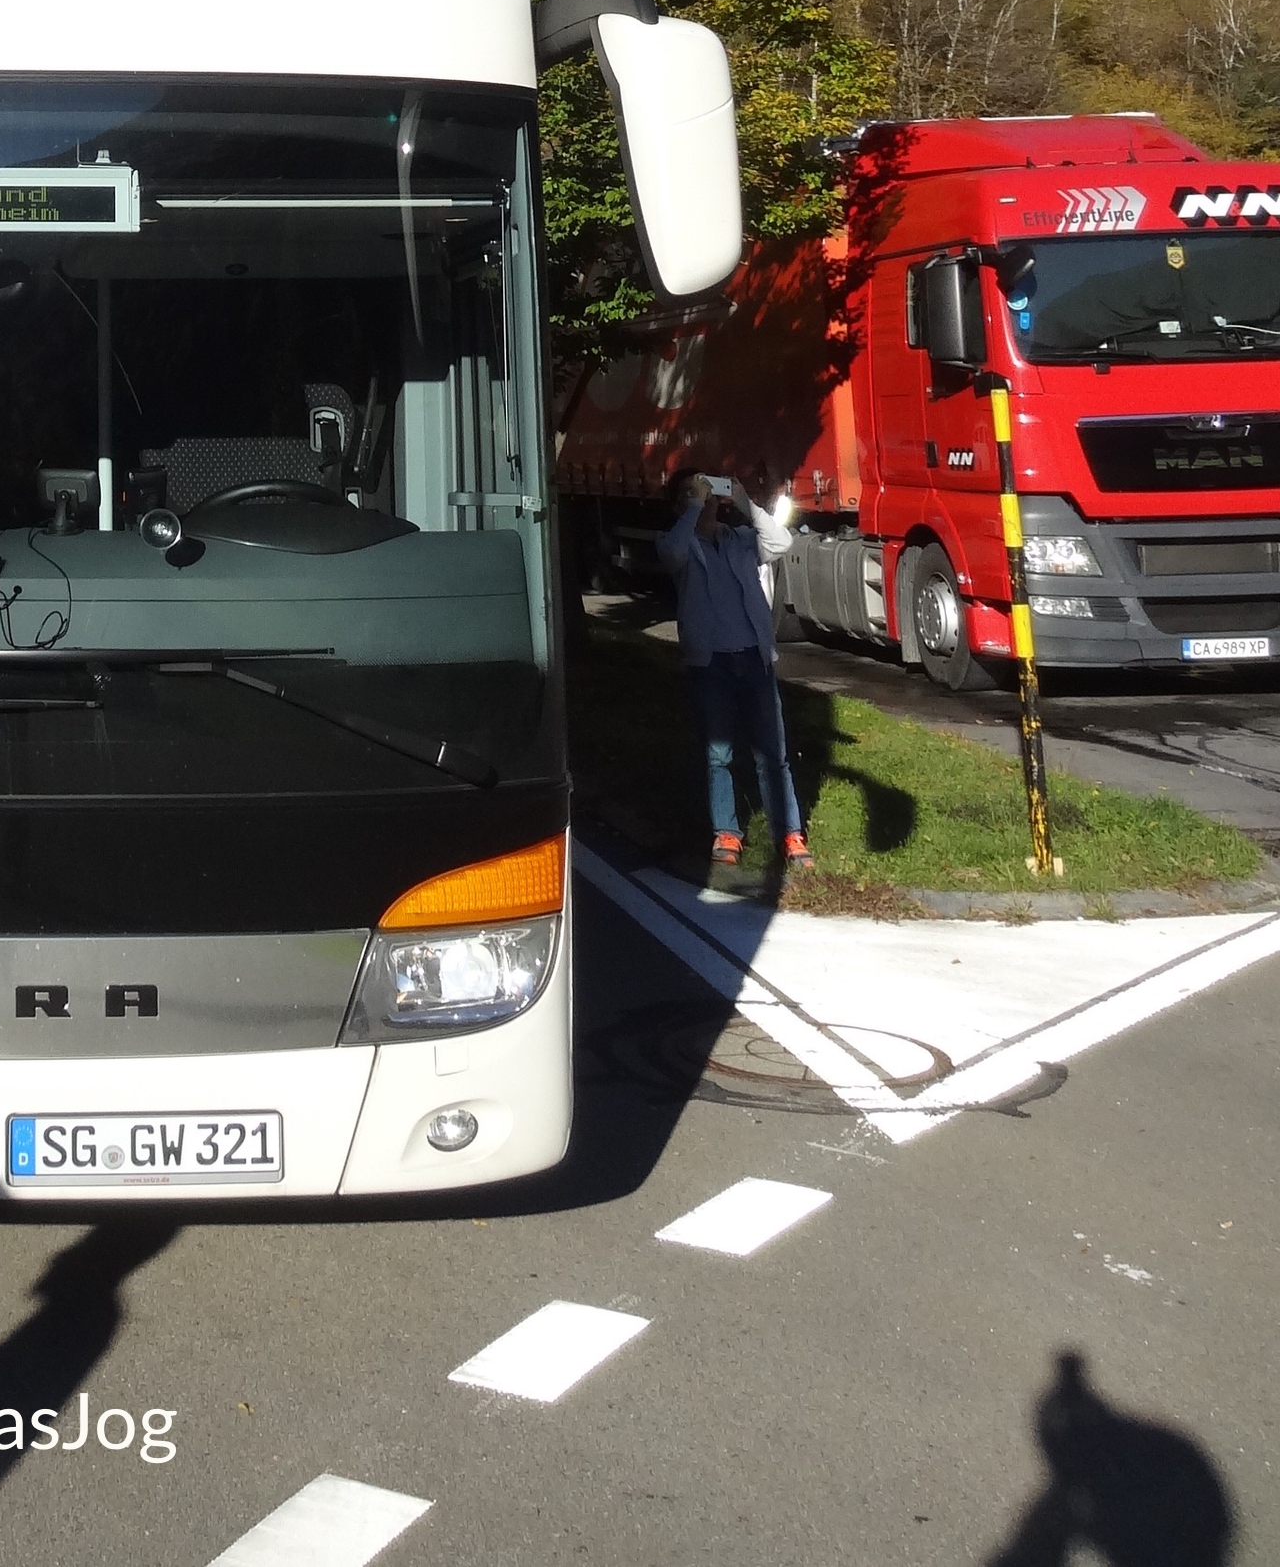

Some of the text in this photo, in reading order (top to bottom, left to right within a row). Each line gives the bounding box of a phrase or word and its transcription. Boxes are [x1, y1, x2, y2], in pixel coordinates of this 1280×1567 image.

[1023, 207, 1135, 228] EfficientLine
[1153, 445, 1264, 469] MAN
[1193, 640, 1266, 656] CA 6989 XP
[18, 1122, 275, 1168] D SG GW 321
